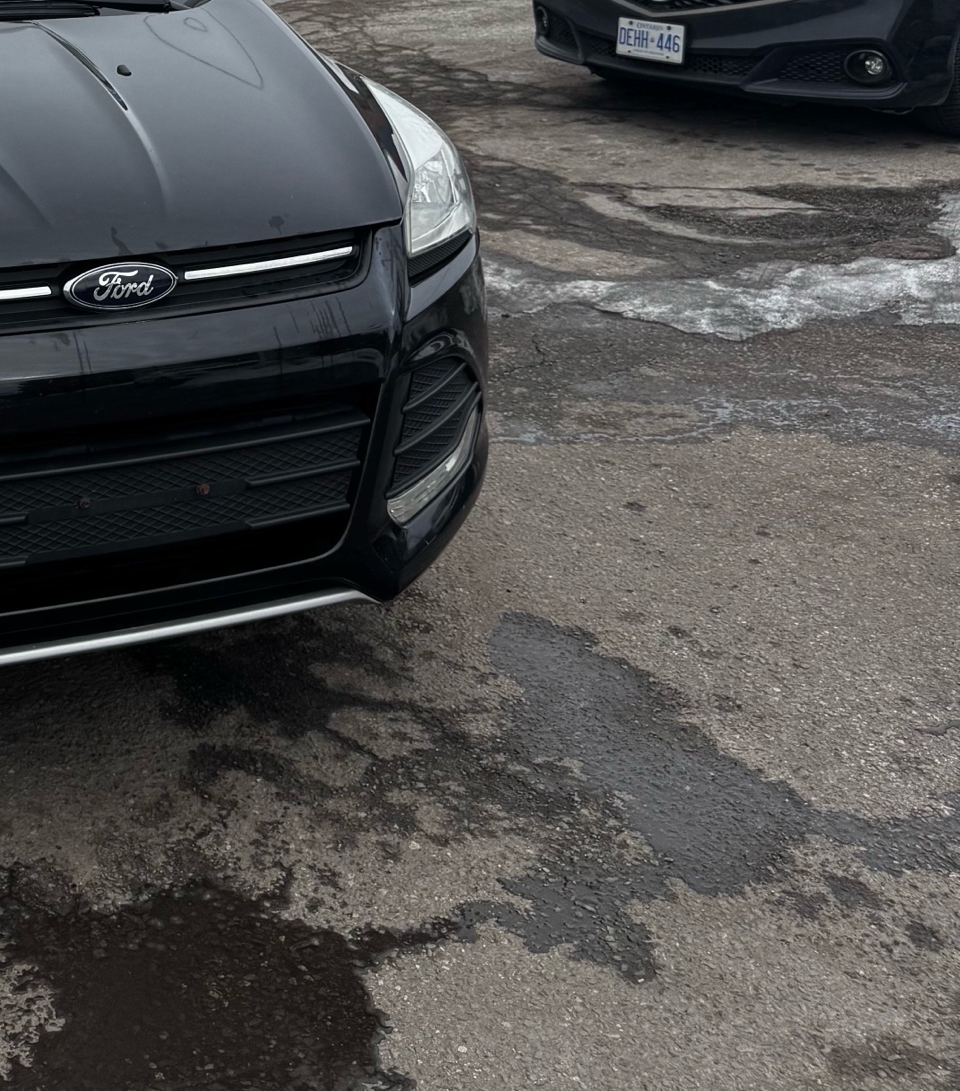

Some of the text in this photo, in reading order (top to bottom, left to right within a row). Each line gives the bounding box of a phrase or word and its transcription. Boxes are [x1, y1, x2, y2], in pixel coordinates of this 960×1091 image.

[618, 26, 649, 49] DEHH
[655, 32, 681, 53] 446
[636, 21, 664, 32] ONTARIO
[93, 270, 154, 301] Ford
